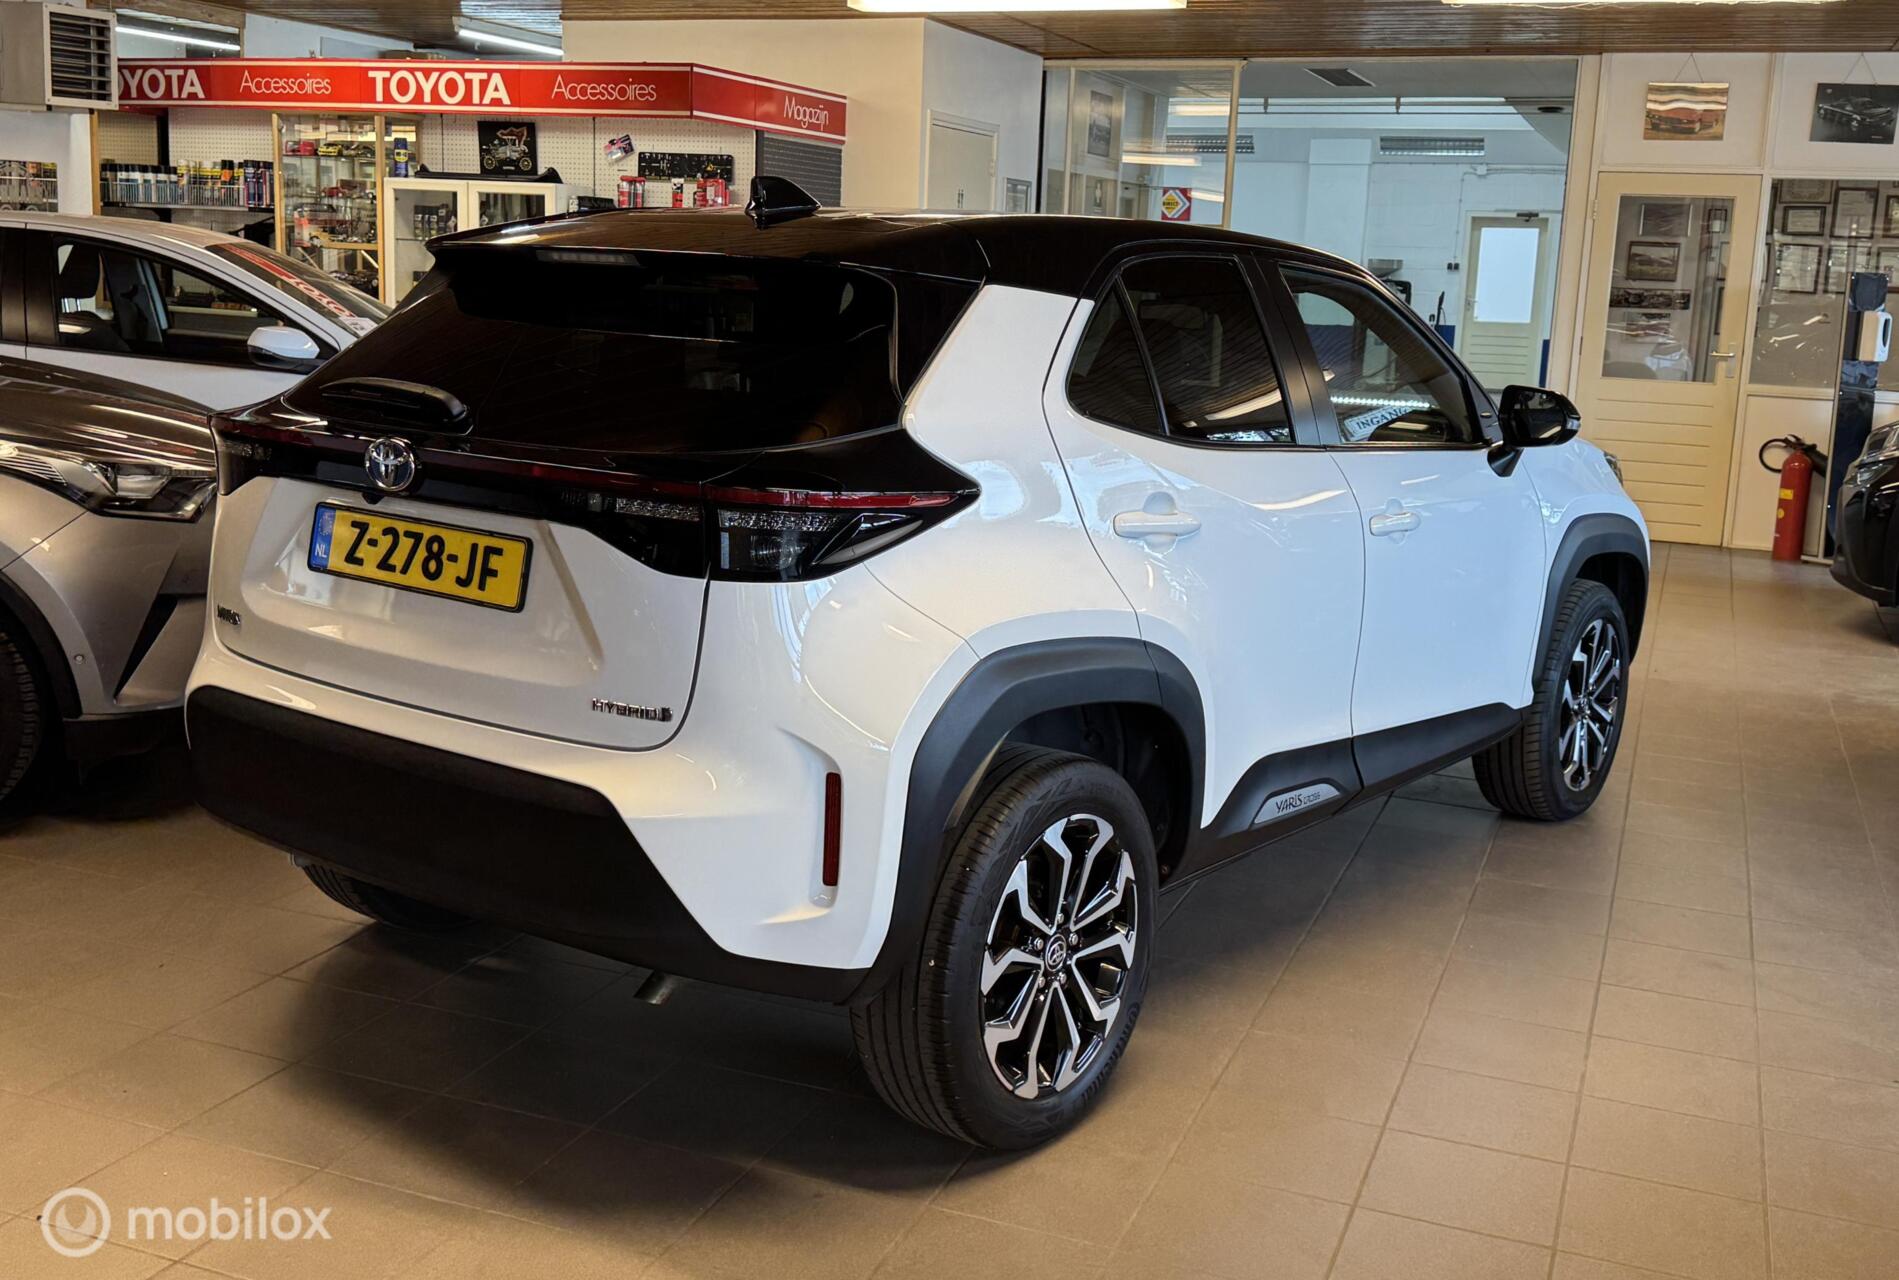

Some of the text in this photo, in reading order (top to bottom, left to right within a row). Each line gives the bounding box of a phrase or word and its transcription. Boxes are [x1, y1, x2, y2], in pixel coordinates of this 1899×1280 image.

[118, 68, 206, 99] YOTA
[239, 70, 332, 96] Accessoires
[368, 70, 512, 106] TOYOTA
[551, 74, 657, 102] Accessoires
[783, 96, 830, 130] Magazijn
[314, 543, 328, 559] NL
[344, 520, 504, 592] Z-278-JF
[592, 697, 659, 721] HYBRID
[1275, 793, 1303, 814] YARIS
